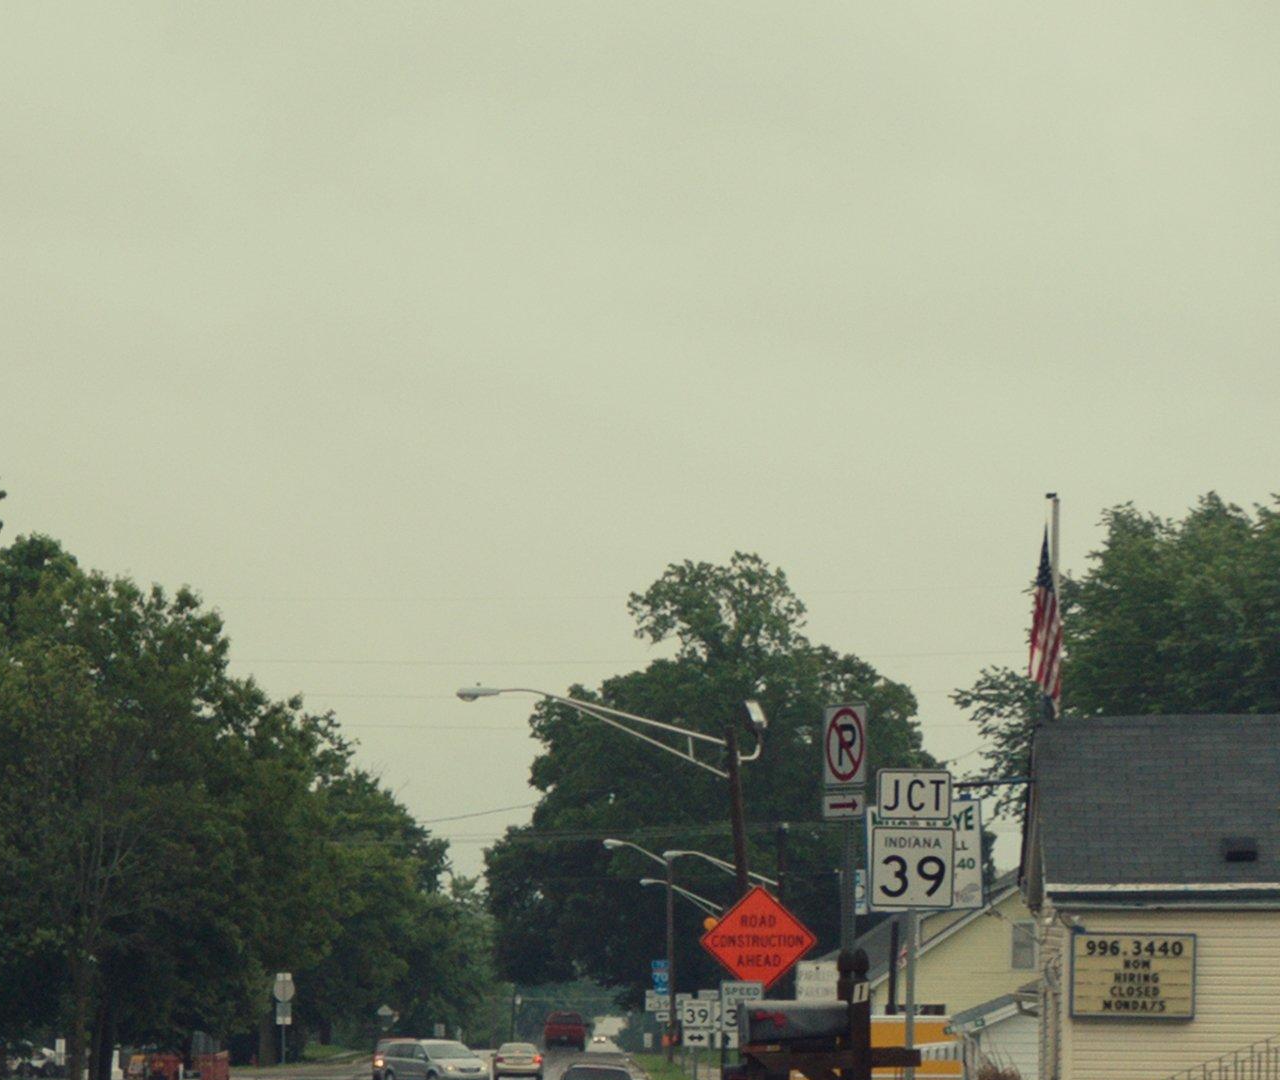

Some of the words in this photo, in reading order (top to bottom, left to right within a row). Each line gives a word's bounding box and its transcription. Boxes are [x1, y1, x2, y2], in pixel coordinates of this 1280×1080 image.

[883, 779, 946, 812] JCT
[884, 836, 942, 849] INDIANA
[879, 854, 946, 898] 39
[739, 913, 776, 927] ROAD
[710, 933, 805, 948] CONSTRUCTION
[1085, 940, 1184, 957] 996.3440
[735, 953, 782, 968] AHEAD
[1114, 972, 1160, 984] HIRING
[724, 986, 761, 996] SPEED
[1109, 986, 1160, 998] CLOSED
[685, 1008, 710, 1025] 39
